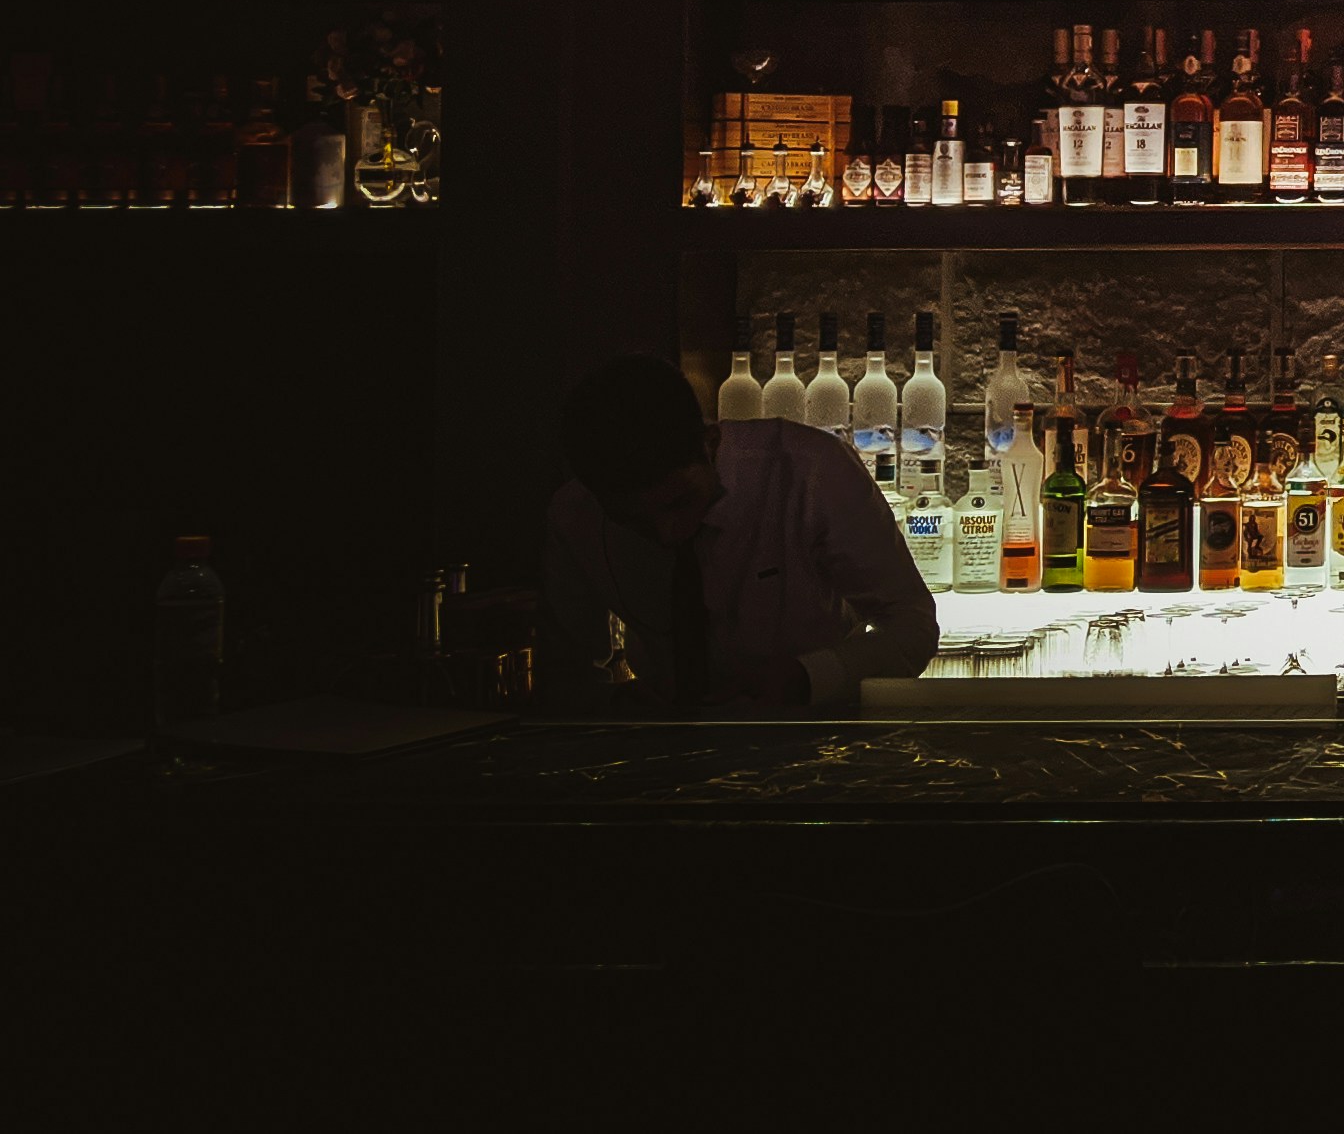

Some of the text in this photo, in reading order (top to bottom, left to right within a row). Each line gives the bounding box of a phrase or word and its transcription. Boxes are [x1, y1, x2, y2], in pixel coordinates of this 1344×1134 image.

[1073, 139, 1083, 149] 12
[1136, 139, 1146, 150] 18
[960, 515, 996, 525] ABSOLUT
[1299, 512, 1314, 526] 51
[909, 525, 938, 534] VODKA
[962, 525, 995, 534] CITRON
